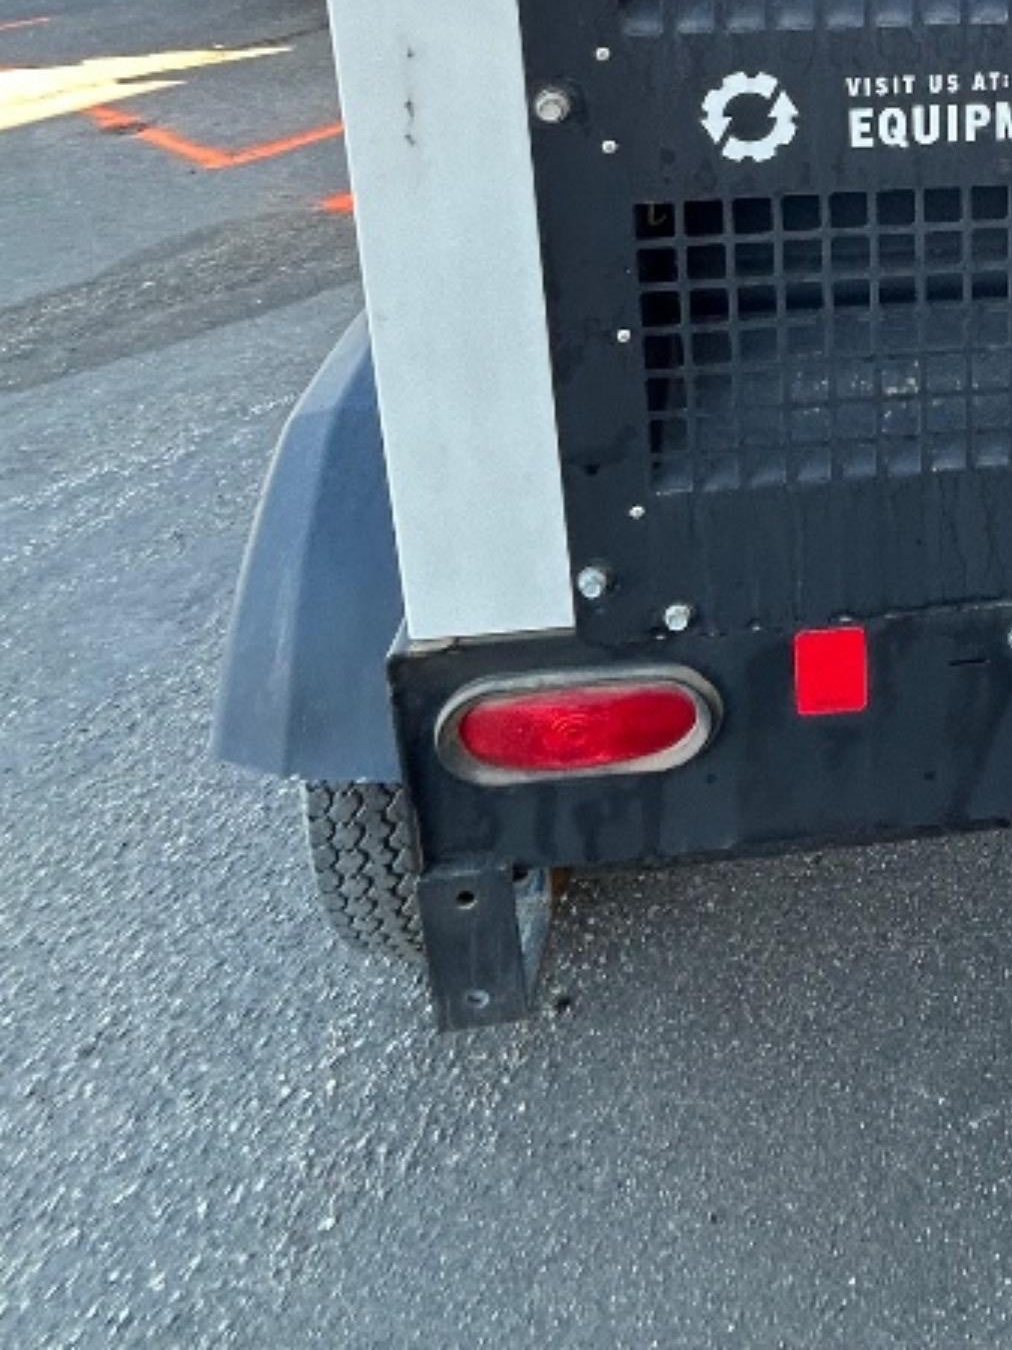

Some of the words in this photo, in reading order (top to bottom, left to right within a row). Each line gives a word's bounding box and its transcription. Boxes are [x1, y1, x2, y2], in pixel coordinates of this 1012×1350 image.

[845, 75, 916, 97] VISIT
[928, 74, 960, 94] US
[971, 71, 1009, 92] AT:
